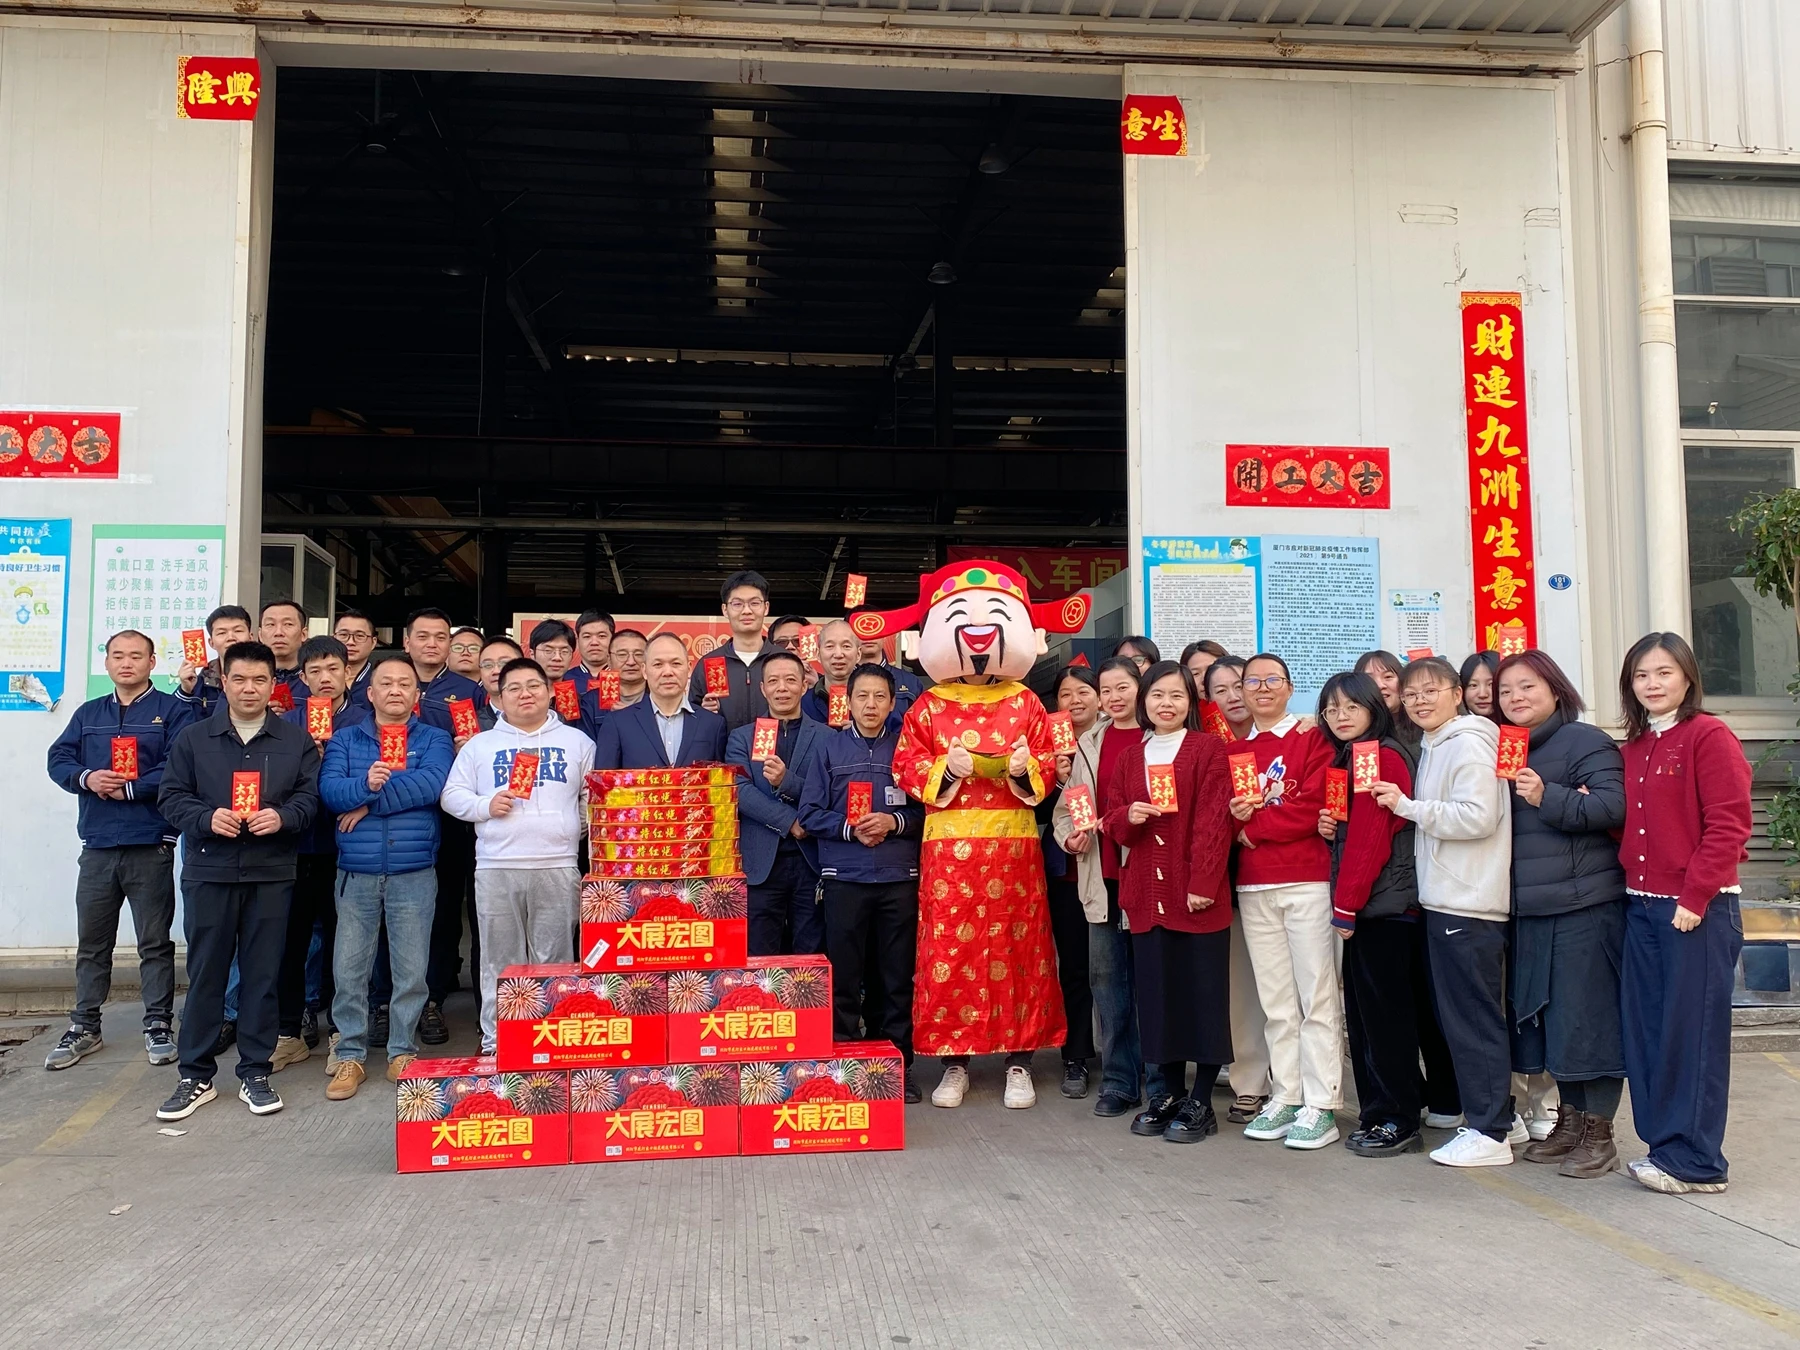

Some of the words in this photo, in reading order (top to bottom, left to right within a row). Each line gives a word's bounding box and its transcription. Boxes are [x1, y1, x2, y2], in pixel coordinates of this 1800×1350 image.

[1236, 457, 1382, 497] 開工大吉
[107, 558, 154, 572] 佩戴口罩
[161, 558, 208, 572] 洗手通风
[106, 578, 153, 592] 减少聚集
[160, 578, 208, 591] 减少流动
[105, 597, 153, 610] 拒传谣言
[160, 597, 207, 610] 配合查验
[106, 616, 153, 629] 科学就医
[160, 616, 207, 630] 留厦过年
[617, 921, 714, 948] 大展宏图
[533, 1018, 632, 1047] 大展宏图
[700, 1012, 796, 1039] 大展宏图
[605, 1109, 704, 1138] 大展宏图
[773, 1103, 869, 1131] 大展宏图
[432, 1116, 533, 1148] 大展宏图
